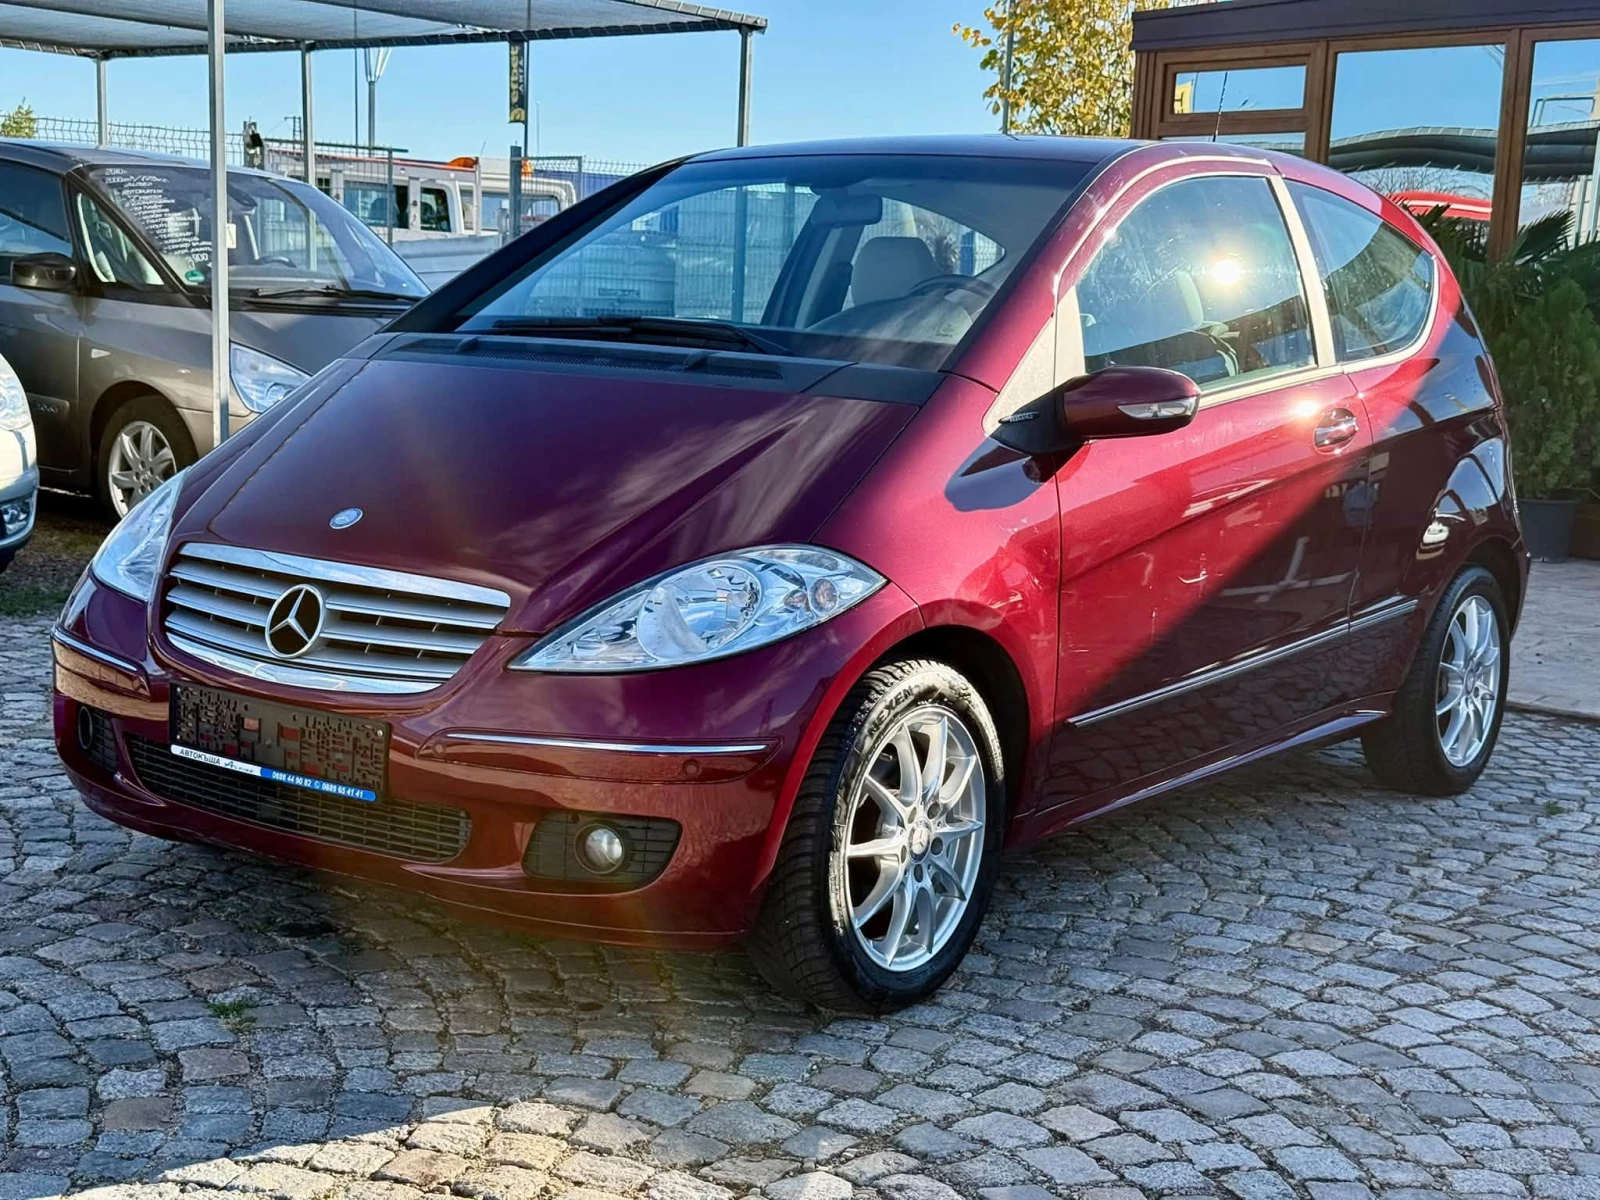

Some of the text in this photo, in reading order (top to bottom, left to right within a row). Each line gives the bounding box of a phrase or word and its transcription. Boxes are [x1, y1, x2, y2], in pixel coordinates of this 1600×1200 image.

[867, 685, 915, 739] NEXEN
[287, 774, 294, 783] 44
[304, 778, 312, 787] 82
[346, 787, 354, 796] 41
[355, 788, 363, 798] 41
